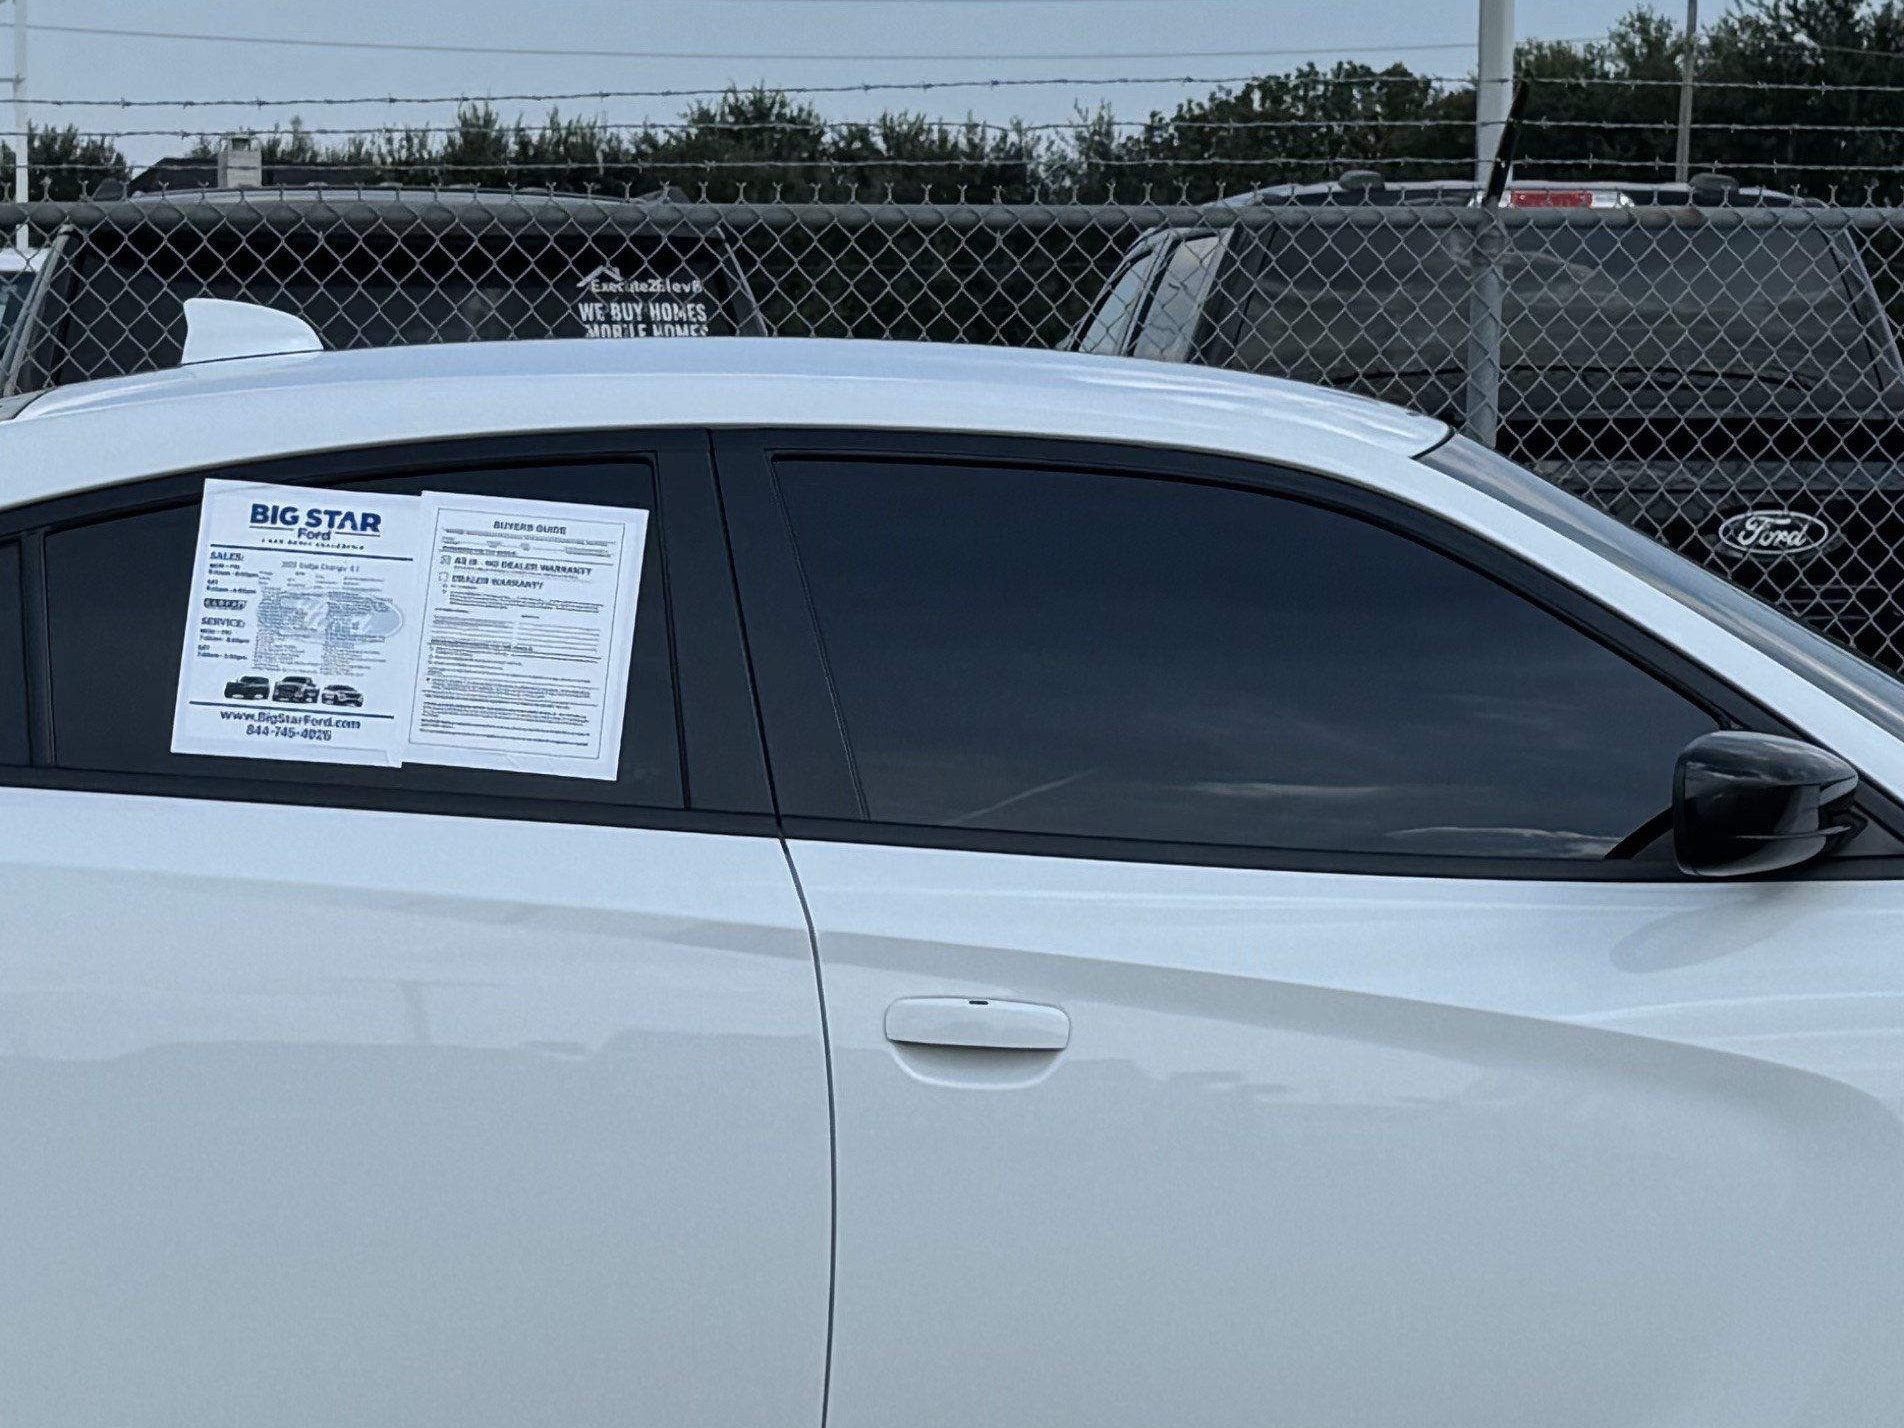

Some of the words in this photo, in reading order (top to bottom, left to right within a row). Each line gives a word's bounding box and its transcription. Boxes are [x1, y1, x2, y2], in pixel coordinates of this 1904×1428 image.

[578, 302, 605, 321] WE
[610, 302, 643, 321] BUY
[649, 302, 707, 322] HOMES
[652, 323, 708, 338] HOMES
[250, 503, 299, 526] BIG
[305, 508, 382, 533] STAR
[297, 527, 332, 541] Ford
[1737, 516, 1809, 546] Ford
[220, 710, 361, 730] www.BigStarFord.com
